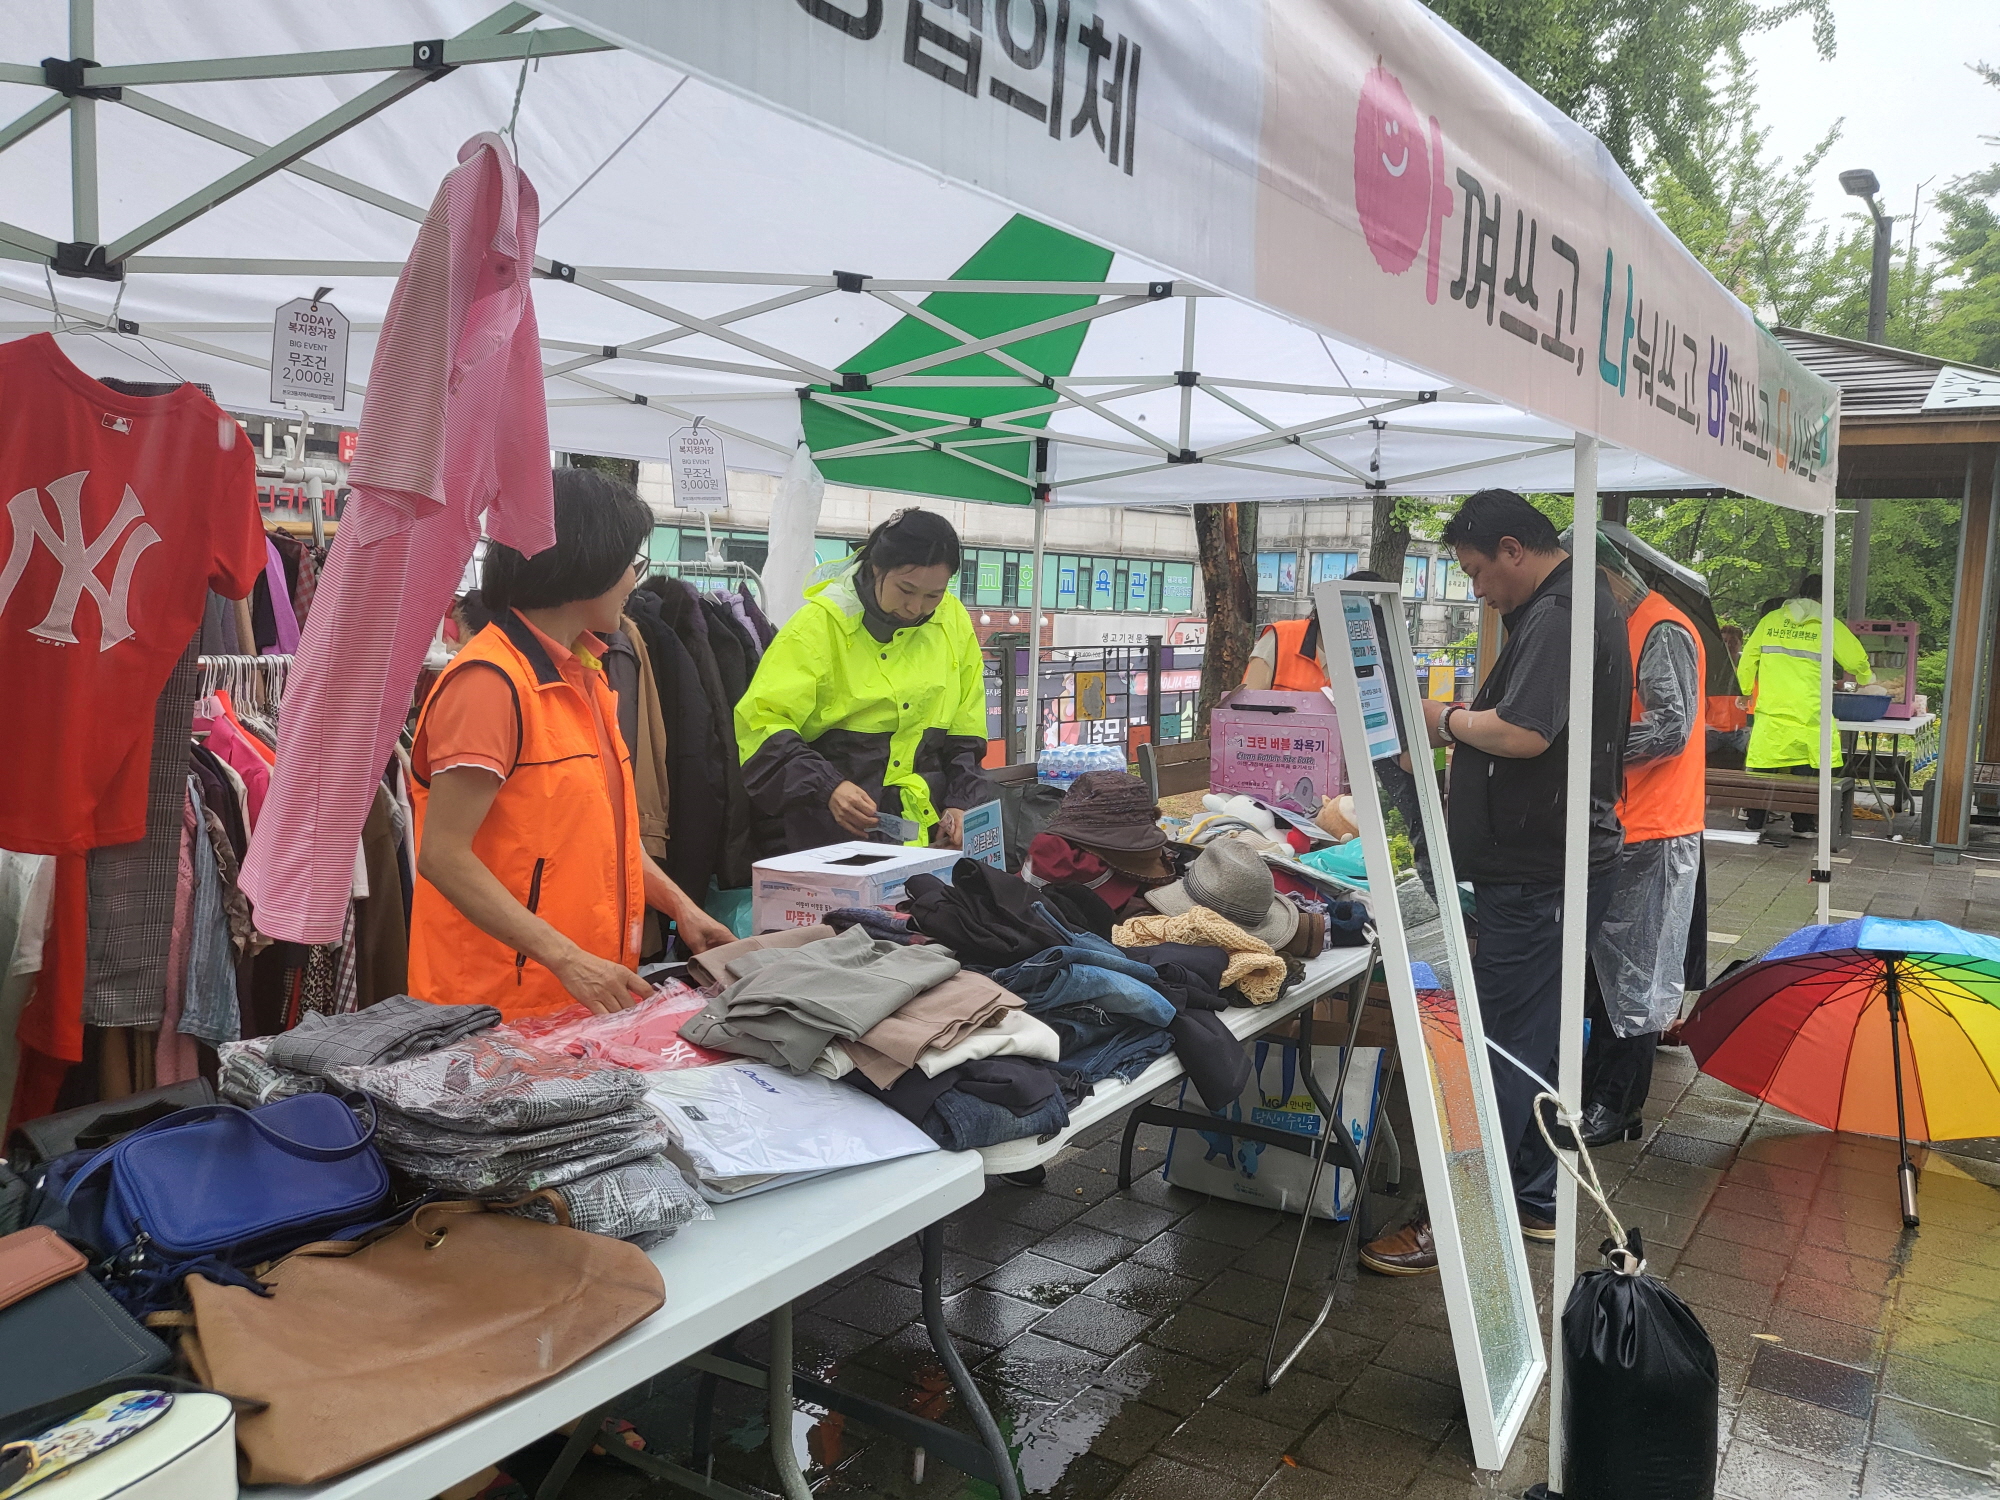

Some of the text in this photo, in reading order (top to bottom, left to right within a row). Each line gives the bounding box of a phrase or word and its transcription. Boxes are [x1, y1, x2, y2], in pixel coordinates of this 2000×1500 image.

[797, 0, 1141, 177] 협의체
[294, 312, 333, 326] TODAY
[288, 322, 336, 339] 복지정거장
[289, 340, 328, 352] BIG EVENT
[288, 352, 327, 370] 무조건
[1599, 247, 1700, 435] 나눠쓰고,
[1708, 335, 1771, 467] 바꿔쓰고,
[283, 367, 334, 386] 2,000원
[679, 446, 714, 455] 복지정거장
[681, 438, 710, 446] TODAY
[683, 468, 711, 479] 무조건
[681, 479, 719, 491] 3,000원
[0, 470, 162, 652] NY
[1060, 568, 1148, 598] 교육관
[1766, 627, 1818, 642] 재난안전대책본부
[1246, 736, 1267, 750] 크린
[1270, 737, 1291, 751] 버블
[1293, 738, 1325, 753] 좌욕기
[1290, 1100, 1313, 1111] 만나면
[1255, 1113, 1316, 1131] 당신이 주인공
